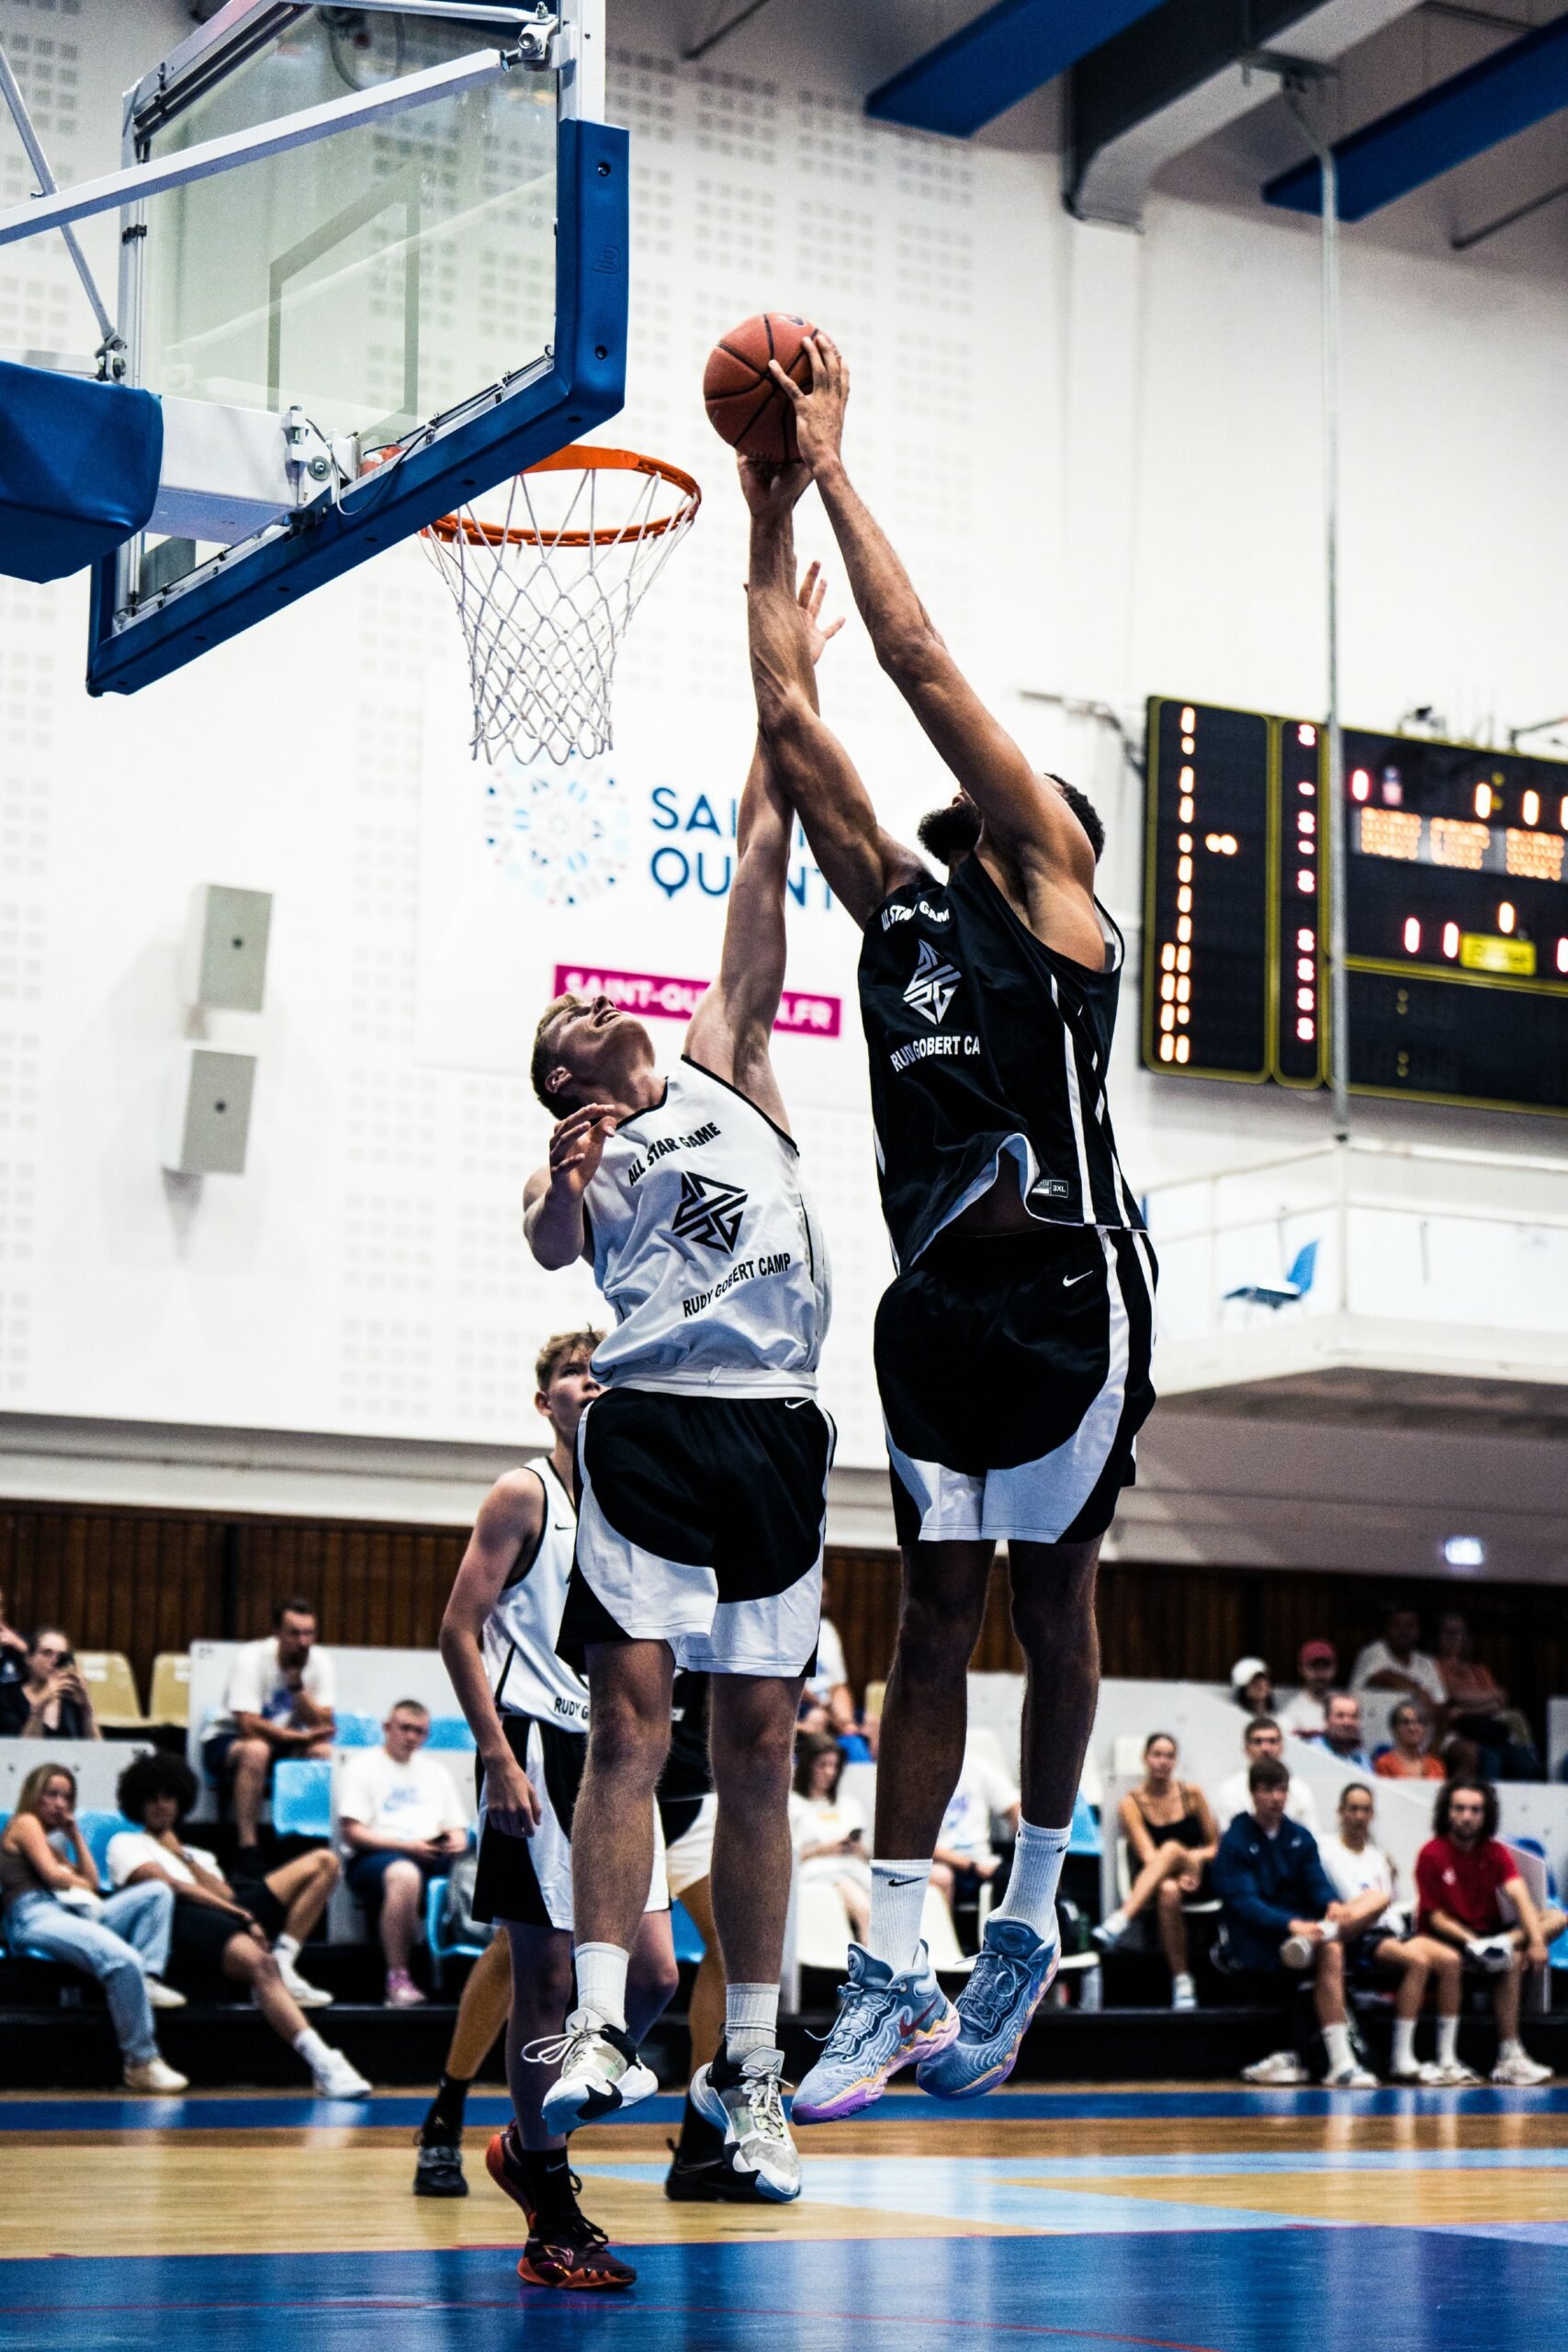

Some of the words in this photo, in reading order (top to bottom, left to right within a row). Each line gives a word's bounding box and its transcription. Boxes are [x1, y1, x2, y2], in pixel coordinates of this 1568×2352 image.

[890, 1044, 916, 1072] RUD
[912, 1035, 961, 1060] GOBERT
[627, 1159, 647, 1187] ALL
[647, 1137, 681, 1167] STAR
[678, 1122, 722, 1148] GAME
[1053, 1184, 1066, 1193] 3XL
[682, 1289, 713, 1317] RUDY
[715, 1260, 754, 1298] GOBERT
[758, 1252, 791, 1276] CAMP
[554, 1697, 581, 1716] RUDY
